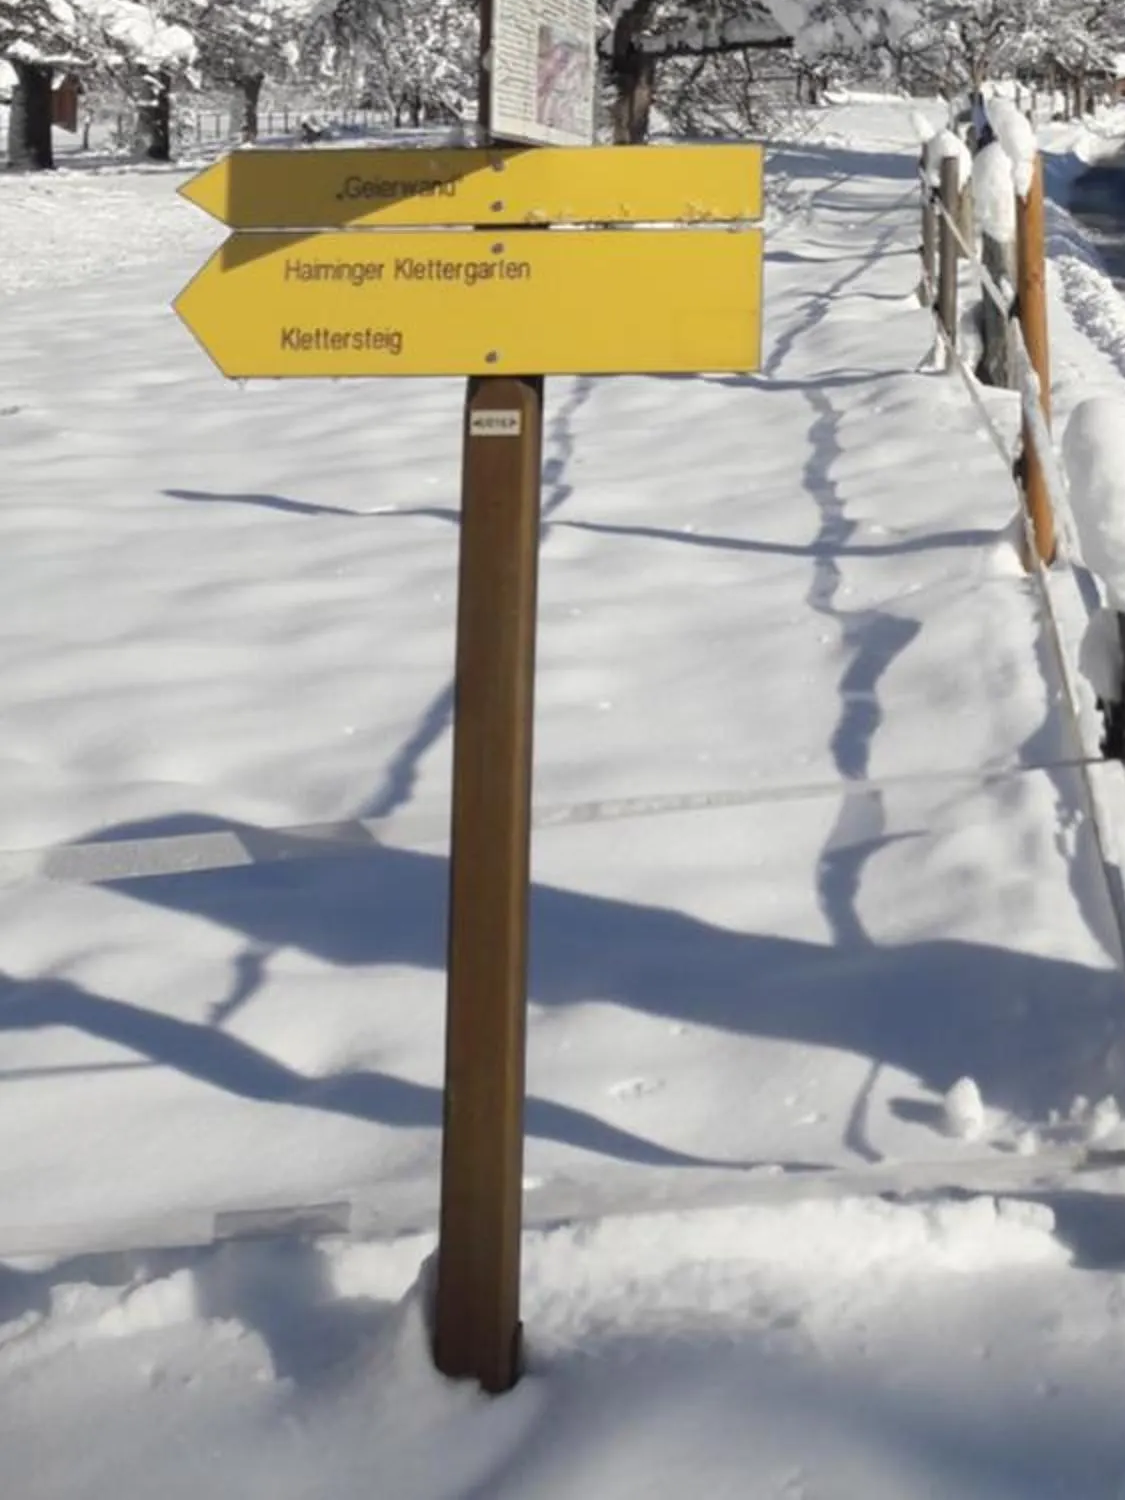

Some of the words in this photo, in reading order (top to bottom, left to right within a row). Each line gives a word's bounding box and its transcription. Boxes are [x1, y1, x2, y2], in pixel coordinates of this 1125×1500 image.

[284, 257, 385, 286] Haiminger
[394, 257, 532, 286] Klettergarten
[281, 327, 404, 356] Klettersteig
